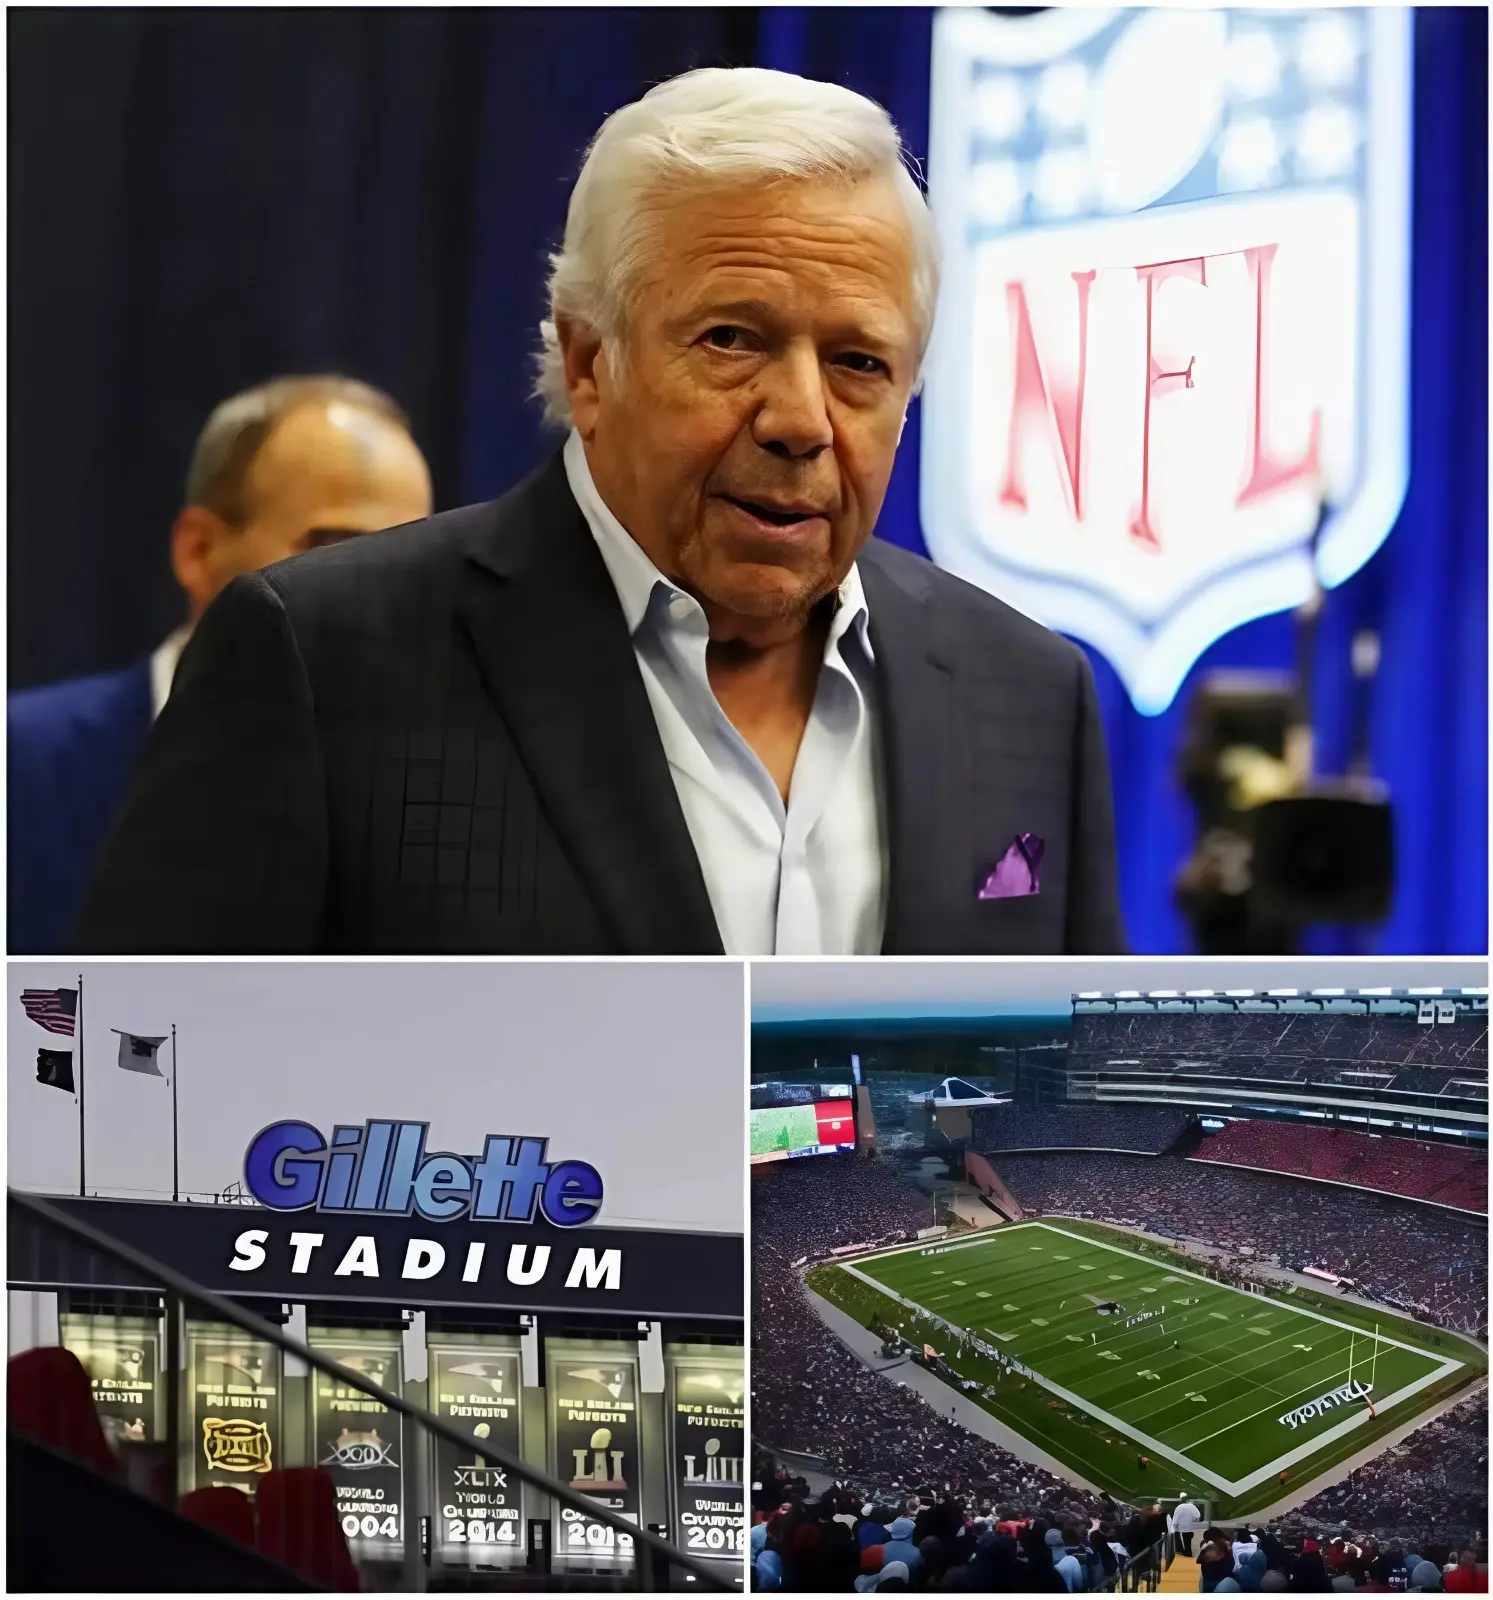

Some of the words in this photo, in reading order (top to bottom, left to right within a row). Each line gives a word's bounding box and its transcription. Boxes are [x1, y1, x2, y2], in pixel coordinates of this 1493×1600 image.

[999, 243, 1321, 554] NFL
[244, 1118, 603, 1228] Gillette
[228, 1229, 622, 1290] STADIUM
[454, 1470, 507, 1488] XLIX
[341, 1514, 399, 1538] 004
[448, 1518, 516, 1542] 2014
